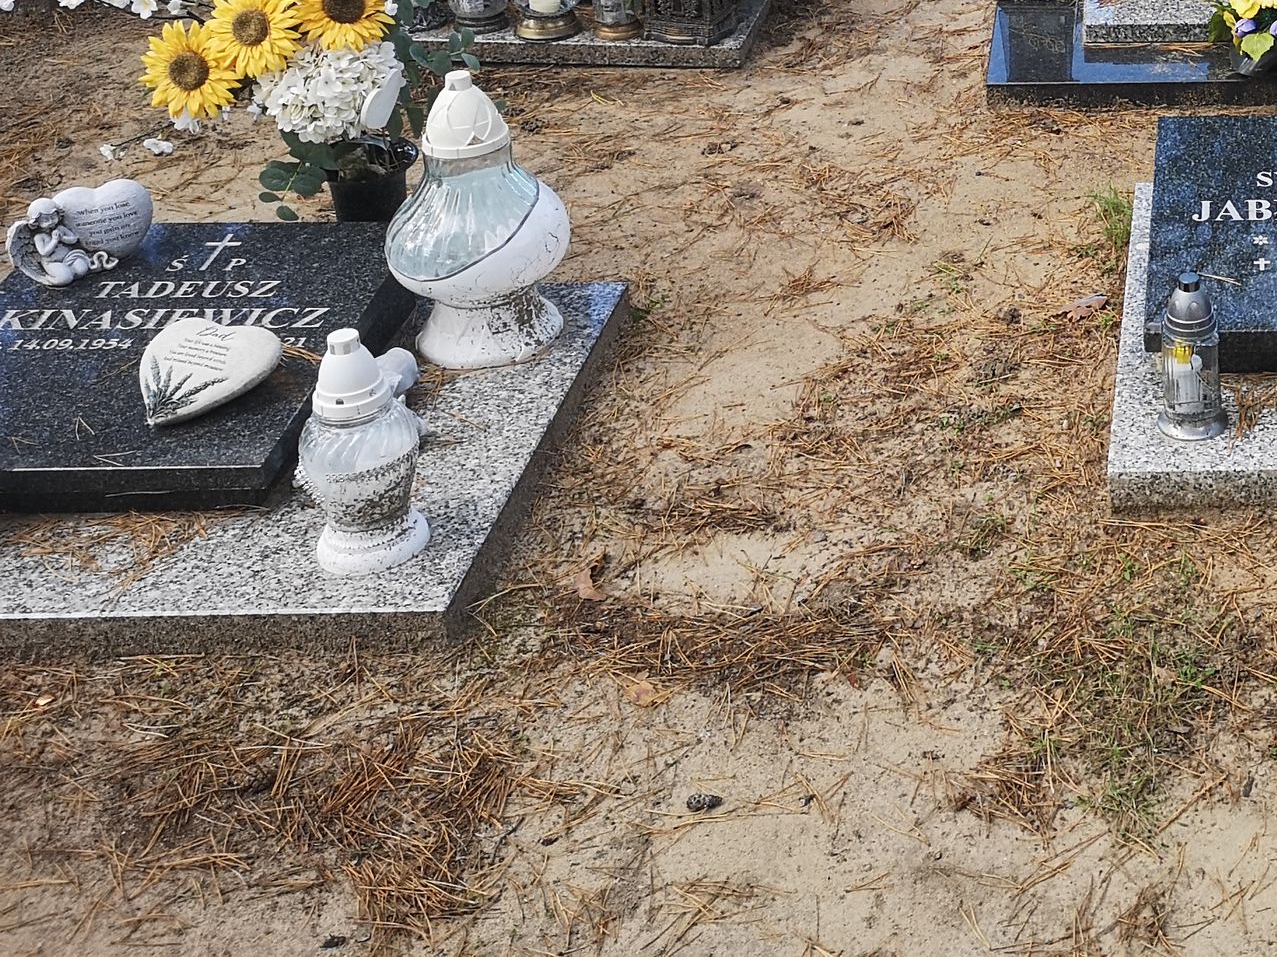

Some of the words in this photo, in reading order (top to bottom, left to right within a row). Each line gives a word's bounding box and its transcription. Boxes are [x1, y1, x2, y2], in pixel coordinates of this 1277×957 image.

[108, 215, 123, 223] you
[223, 258, 247, 272] P
[95, 280, 283, 299] TADEUSZ
[0, 307, 331, 330] KINASIEWICZ
[10, 338, 134, 351] 14.09.1954
